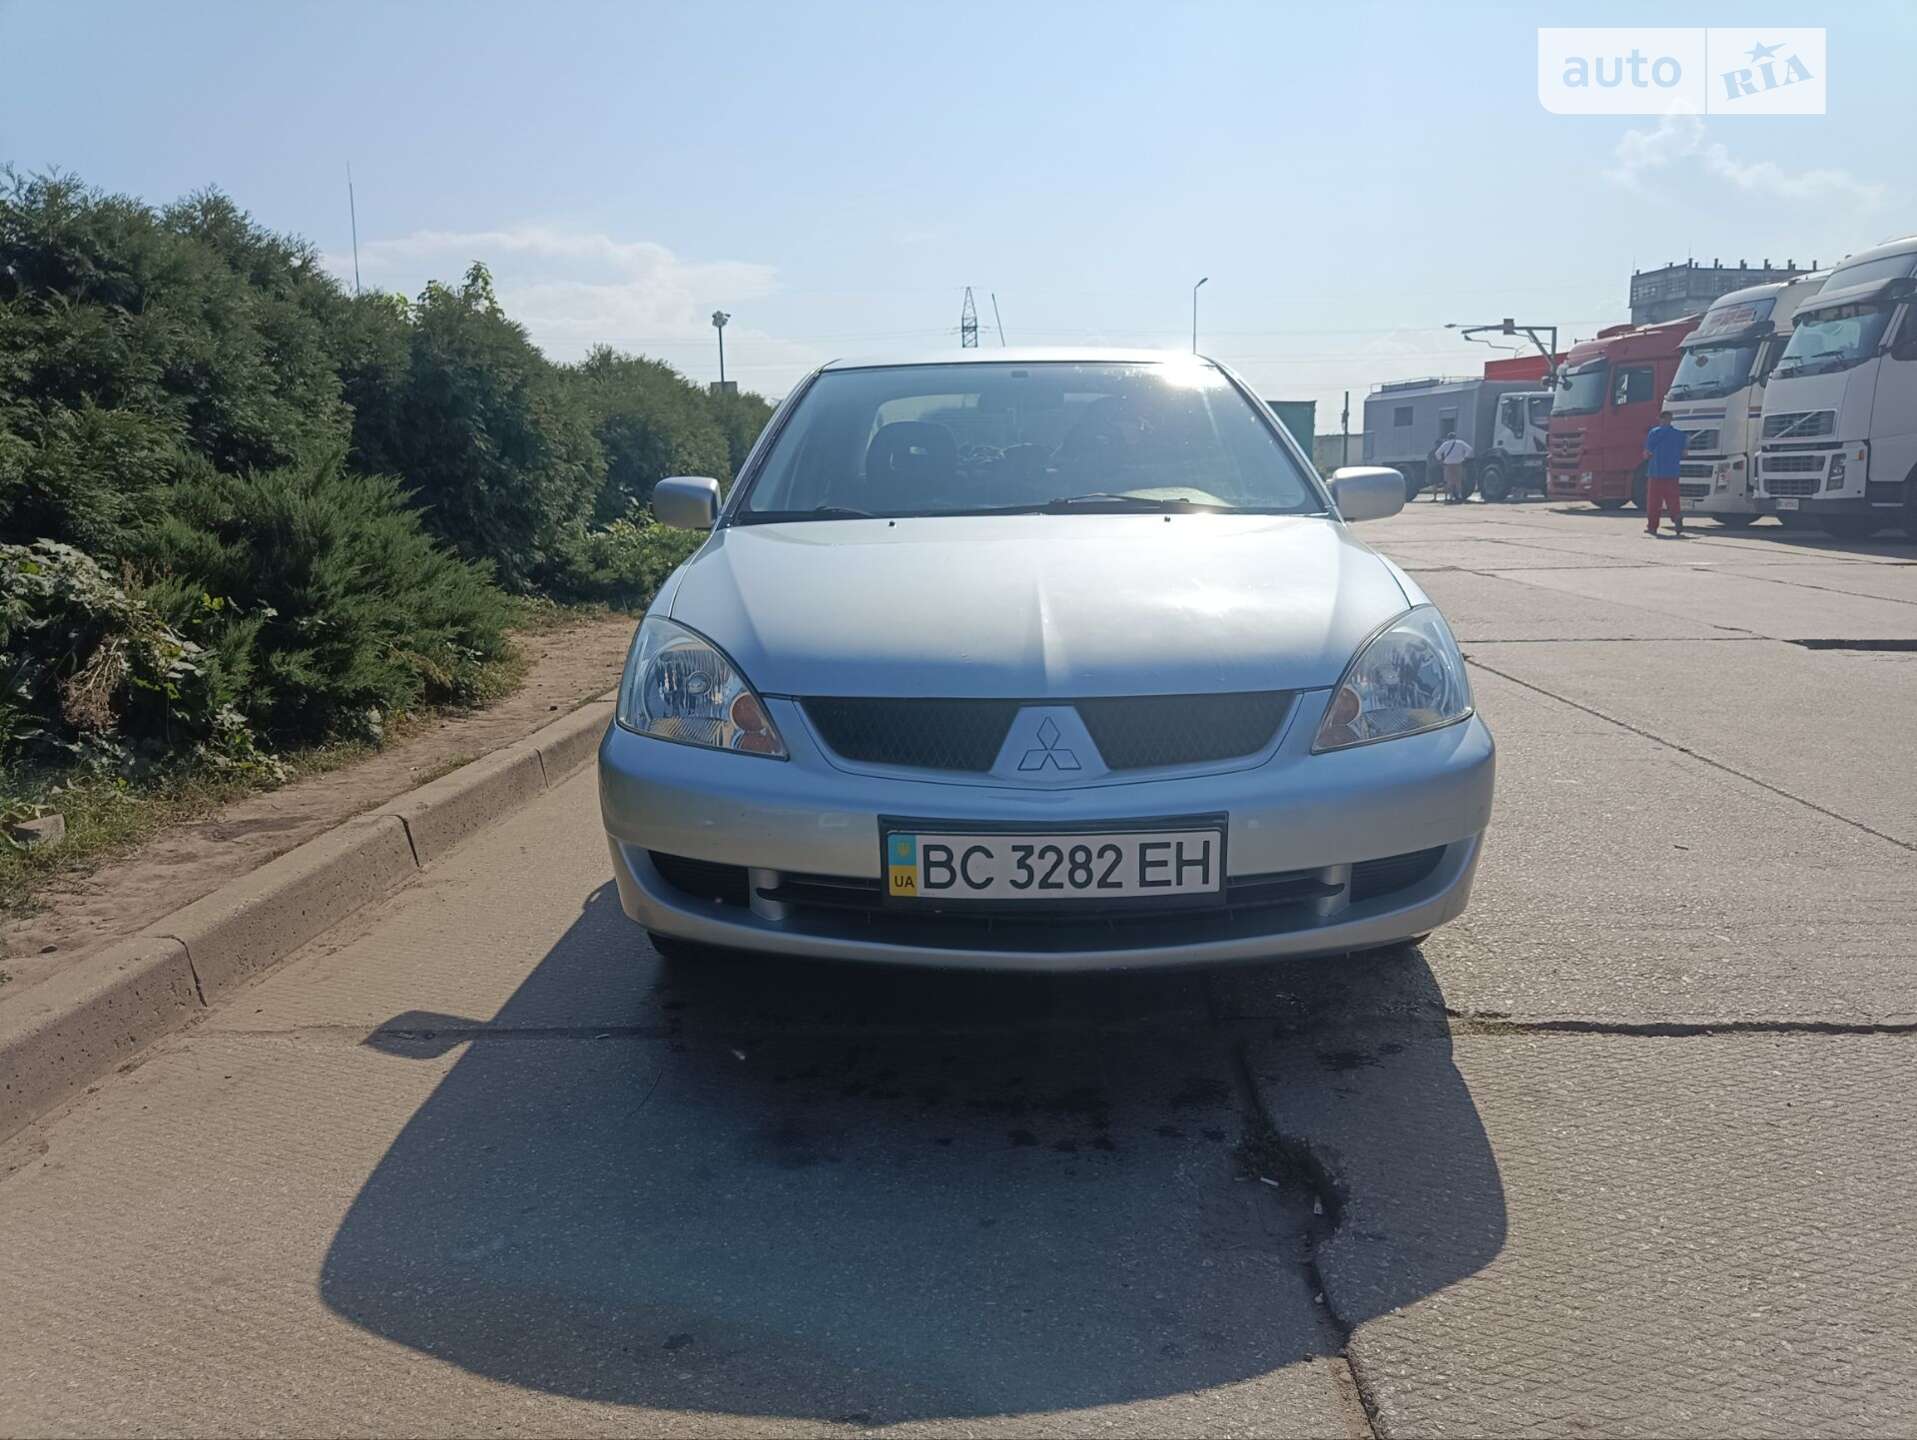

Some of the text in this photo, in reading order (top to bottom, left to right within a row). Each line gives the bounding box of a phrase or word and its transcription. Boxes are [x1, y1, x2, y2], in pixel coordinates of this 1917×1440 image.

[922, 840, 1210, 890] BC 3282 EH
[894, 874, 915, 889] UA
